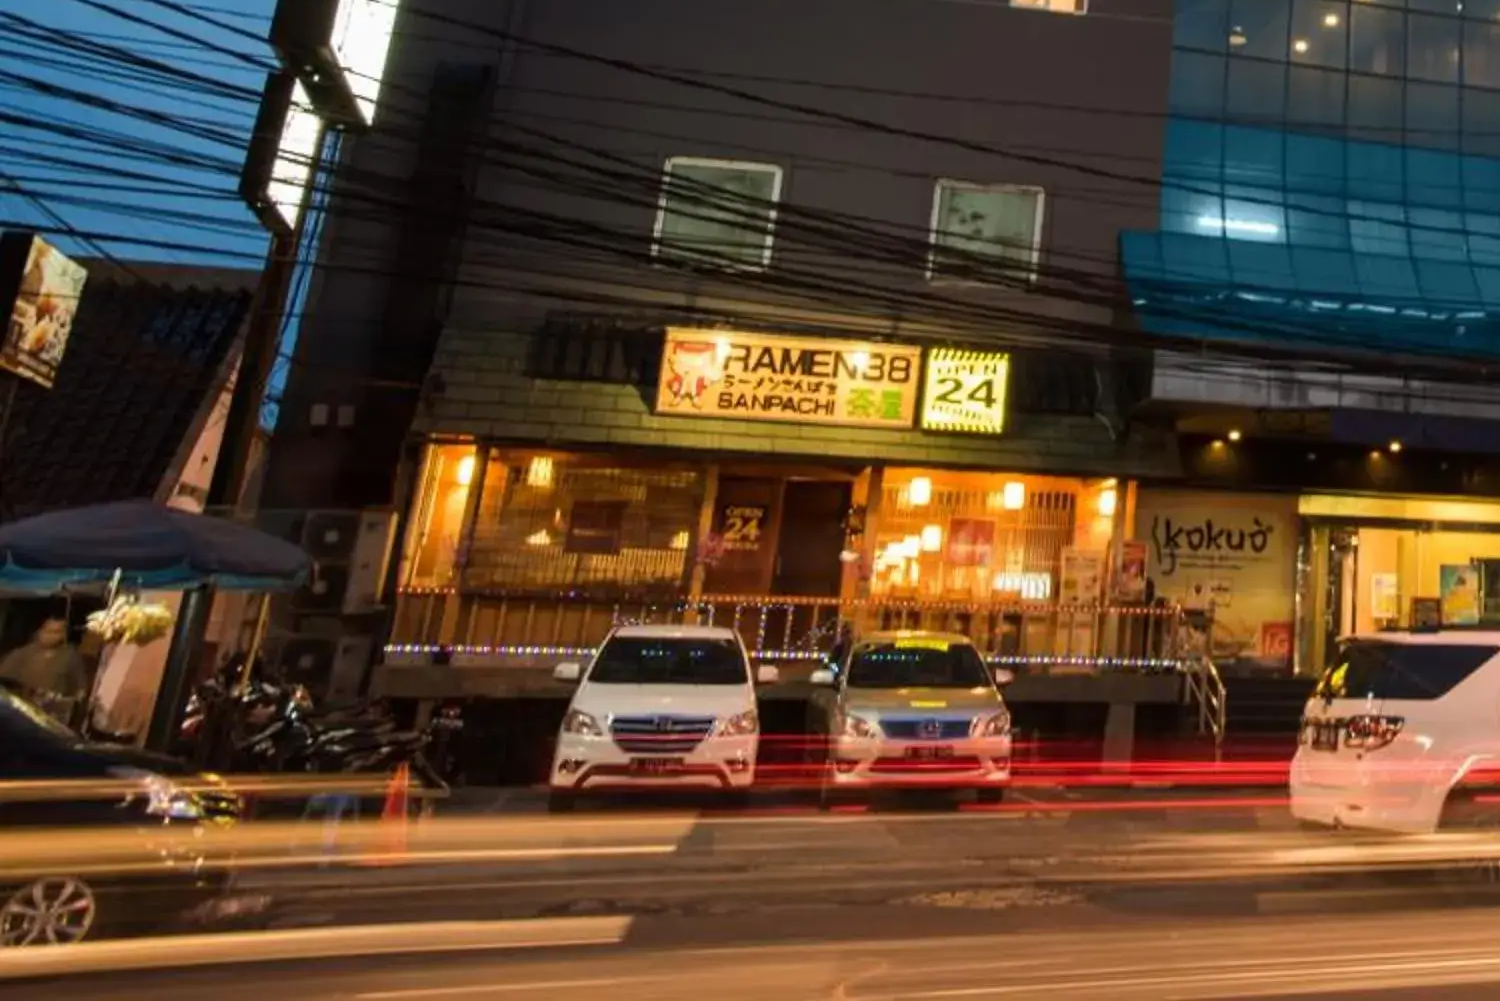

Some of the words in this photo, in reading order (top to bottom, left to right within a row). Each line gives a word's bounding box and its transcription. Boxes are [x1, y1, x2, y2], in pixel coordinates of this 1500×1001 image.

[717, 392, 836, 416] SANPACHI
[934, 378, 997, 408] 24
[723, 517, 761, 541] 24
